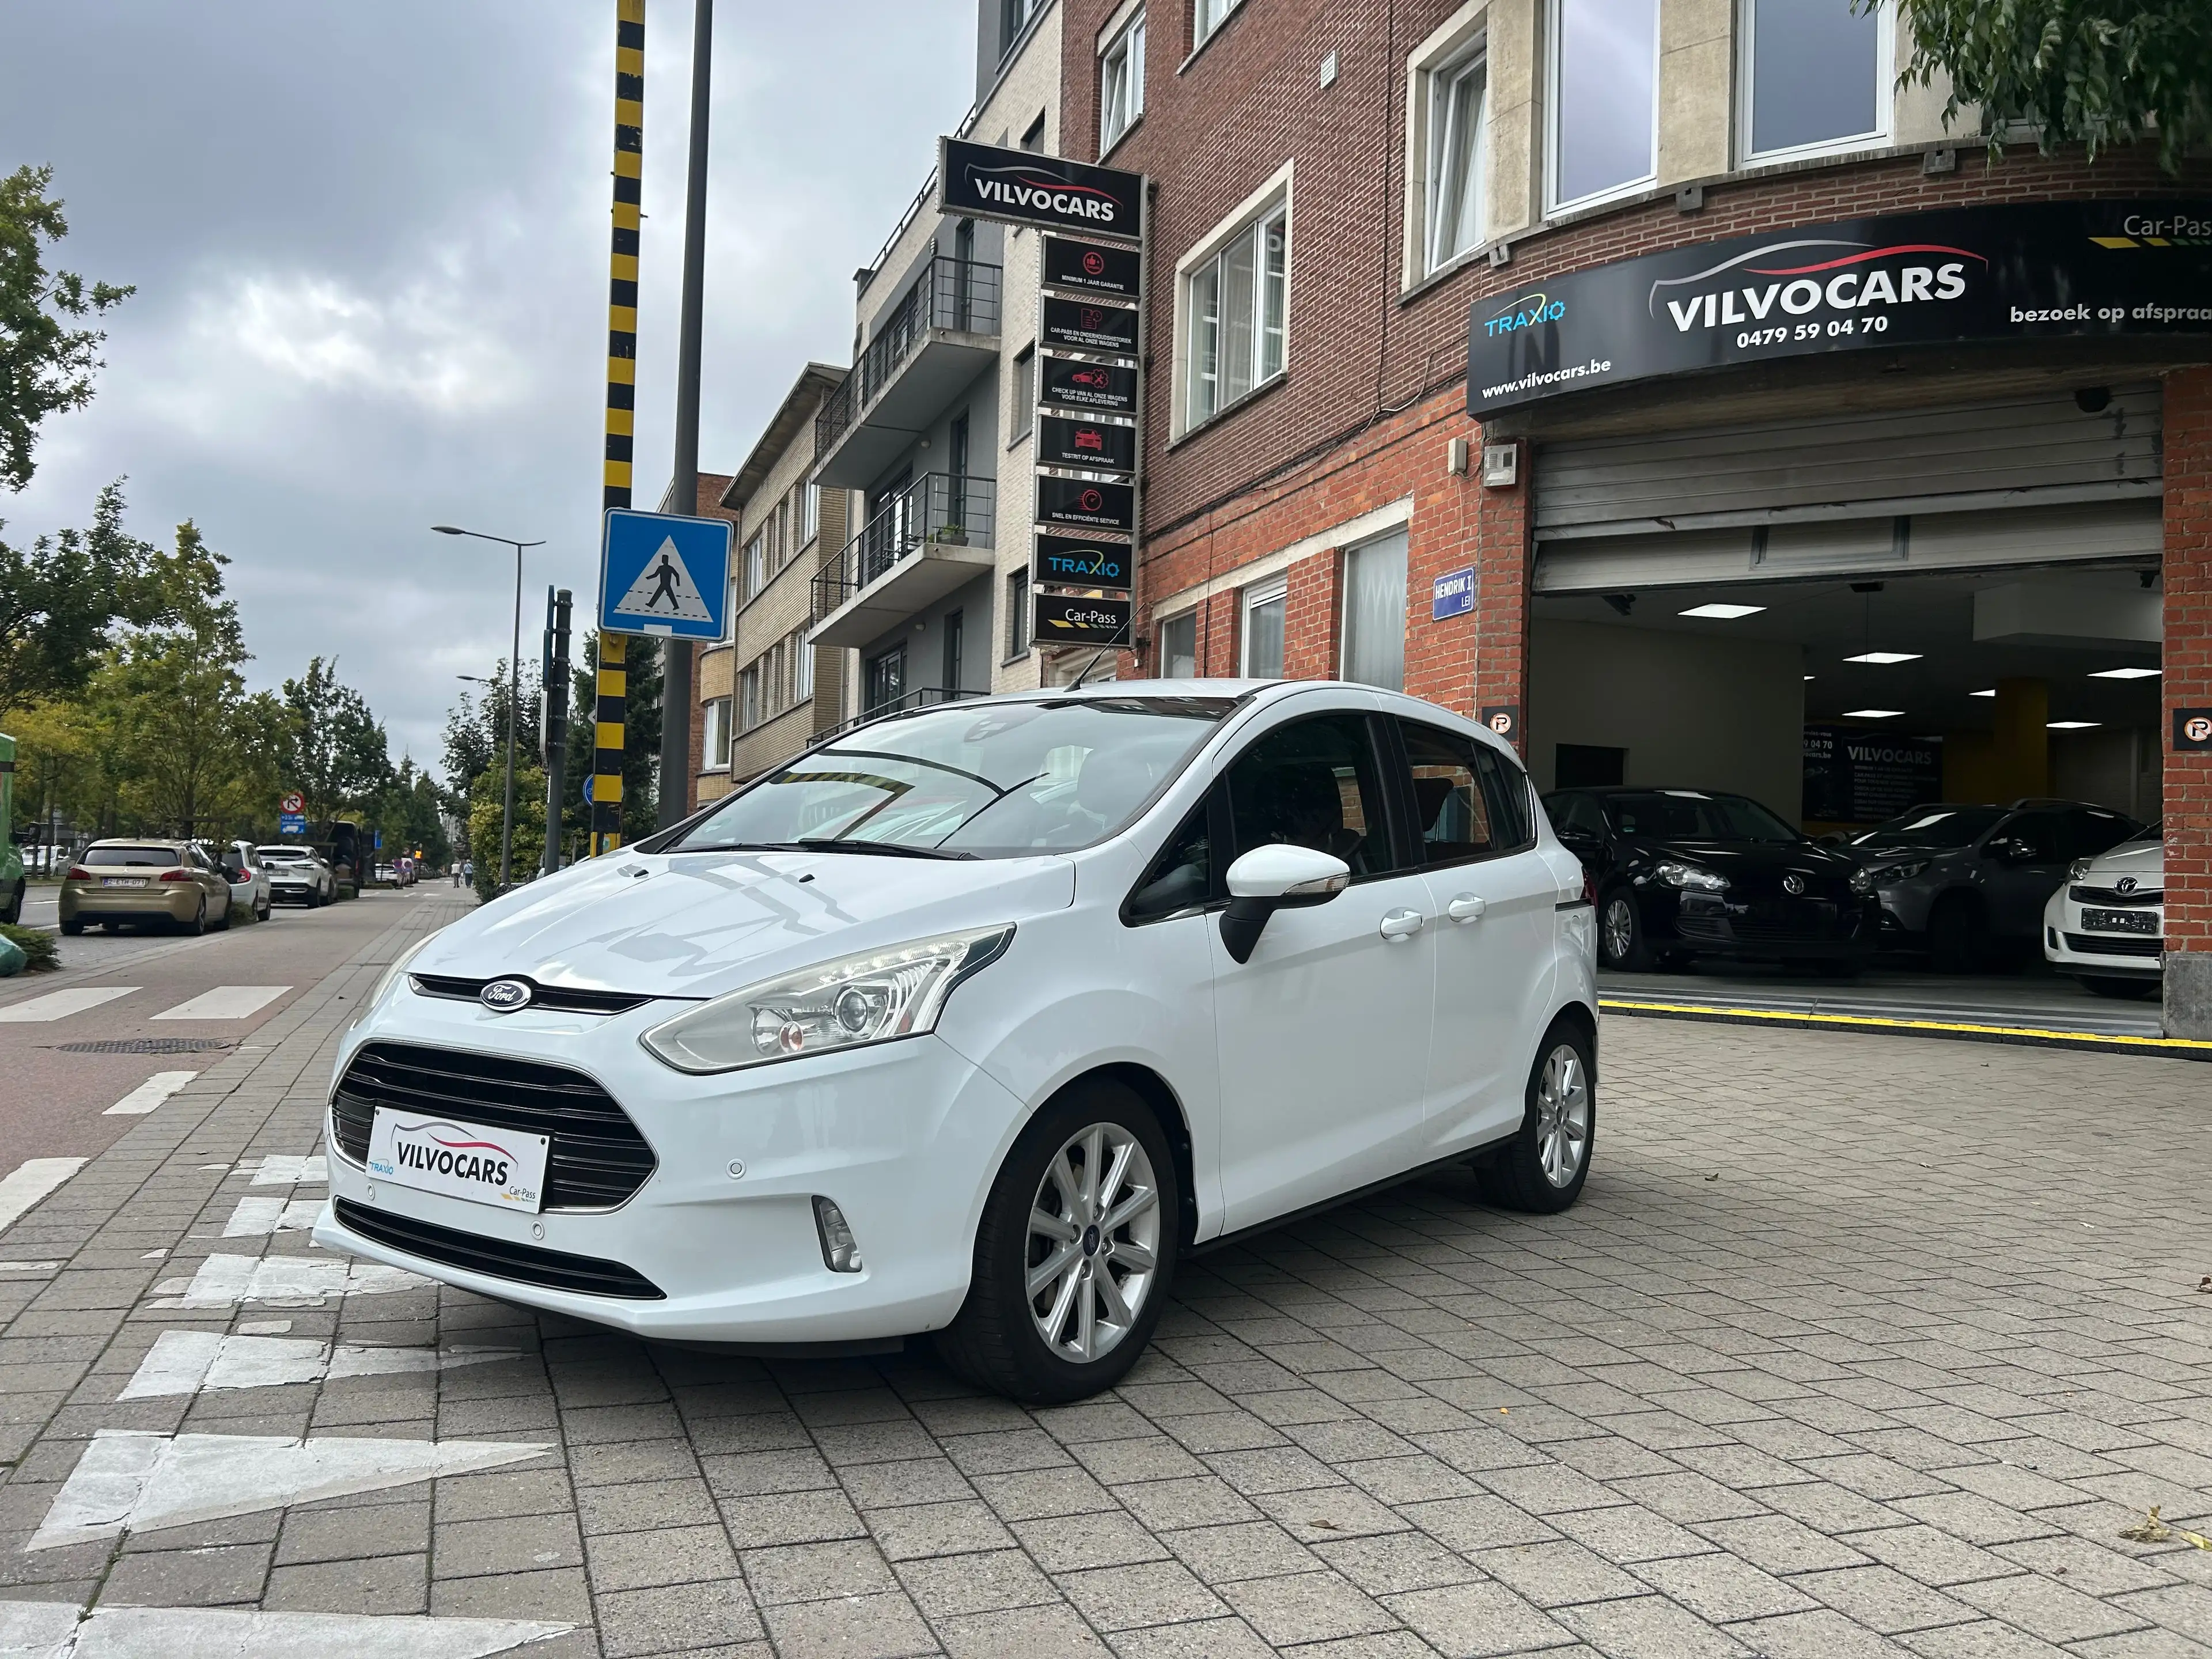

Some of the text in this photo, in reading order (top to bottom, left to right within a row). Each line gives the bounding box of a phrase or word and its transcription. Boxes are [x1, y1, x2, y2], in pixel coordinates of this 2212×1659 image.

[975, 179, 1114, 221] VILVOCARS
[1062, 275, 1082, 283] MINIMUM
[1100, 281, 1124, 290] GARANTIE
[1666, 263, 1965, 332] VILVOCARS
[1484, 300, 1566, 338] TRAXIO
[2010, 304, 2091, 323] bezoek
[2097, 306, 2125, 323] op
[1736, 316, 1888, 349] 0479 59 04 70
[1099, 340, 1119, 348] WAGENS
[1482, 359, 1611, 399] www.vilvocars.be
[1089, 397, 1118, 406] AFLEVERING
[1048, 556, 1120, 577] TRAXIO
[1435, 575, 1472, 600] HENDRIK I
[1461, 596, 1470, 607] LEI
[1065, 608, 1116, 624] Car-Pass
[1810, 740, 1820, 749] 04
[1823, 740, 1832, 749] 70
[1847, 746, 1931, 765] VILVOCARS
[488, 984, 517, 1001] Ford
[369, 1161, 393, 1175] TRAXIO
[397, 1142, 508, 1186] VILVOCARS
[509, 1185, 536, 1199] Car-Pass
